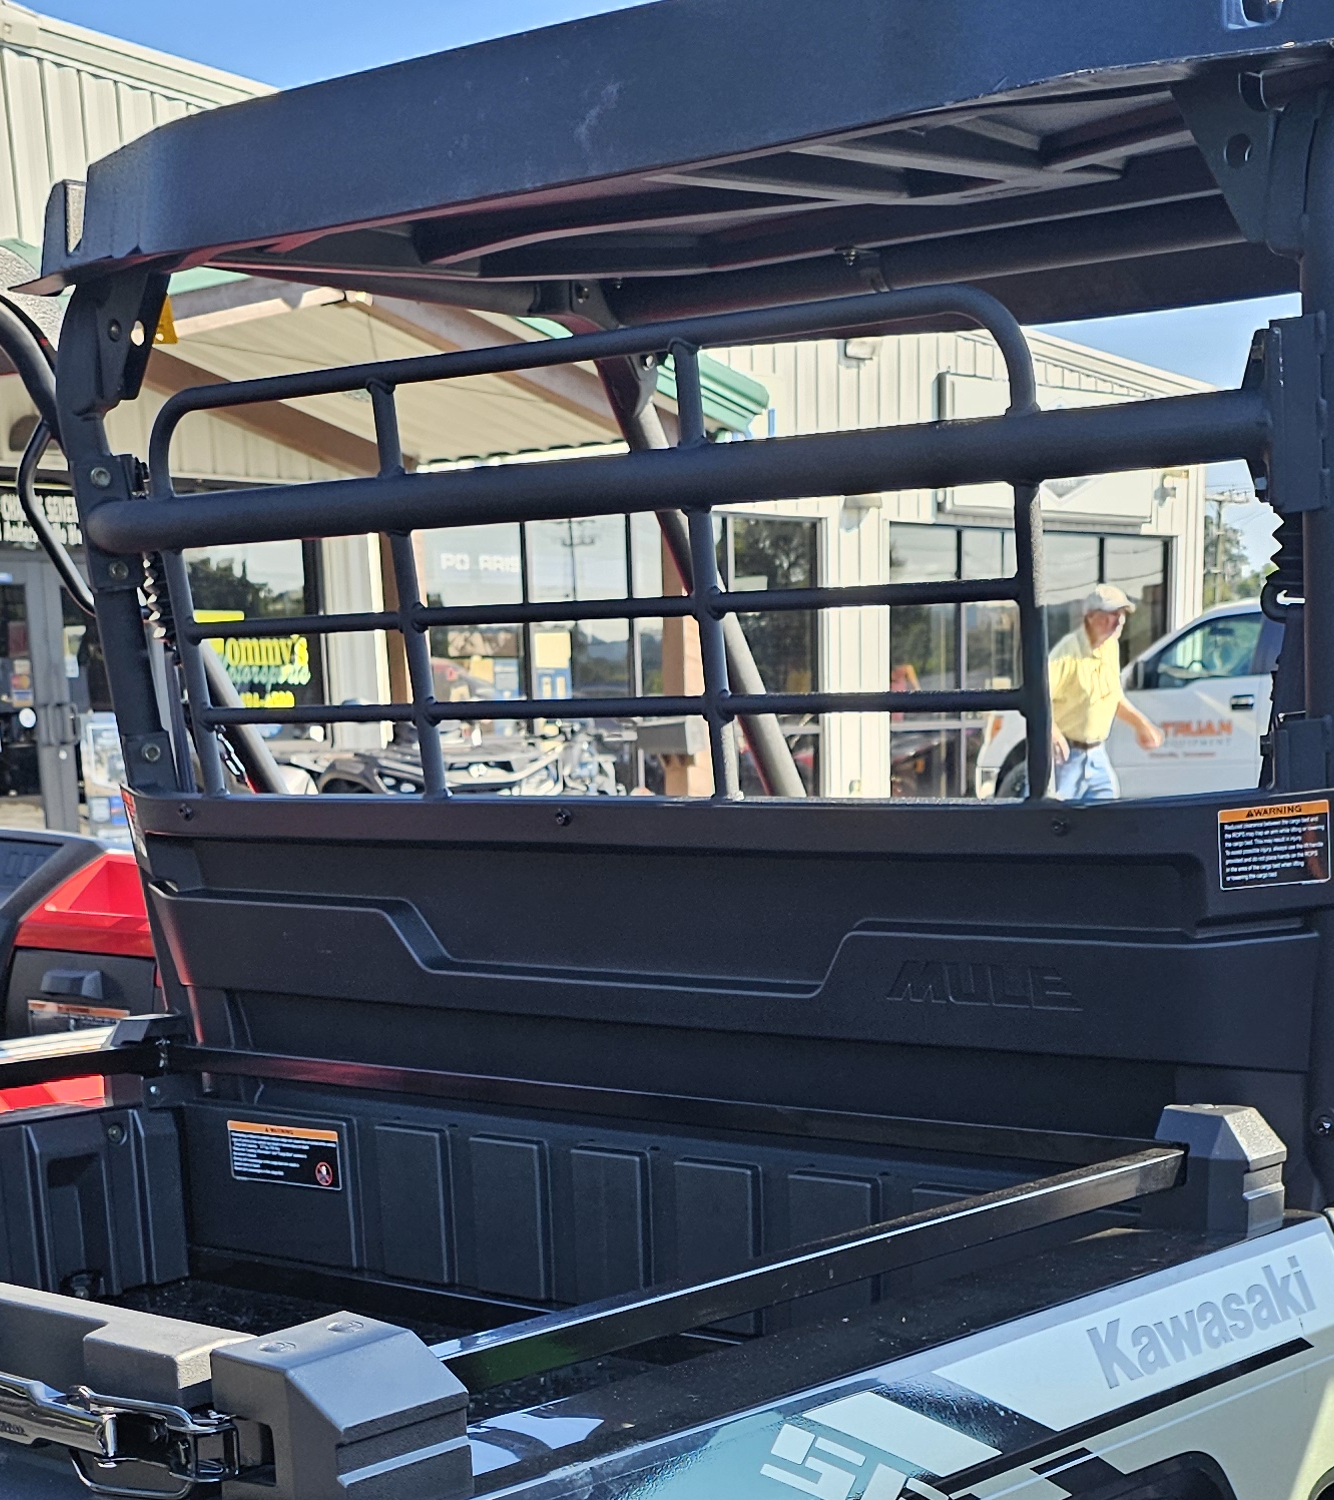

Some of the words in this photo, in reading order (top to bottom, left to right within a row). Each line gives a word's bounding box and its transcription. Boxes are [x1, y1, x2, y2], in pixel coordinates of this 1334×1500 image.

[440, 553, 521, 573] POARIS
[1254, 804, 1302, 817] WARNING
[886, 960, 1085, 1012] MULE
[1085, 1254, 1317, 1390] Kawasaki
